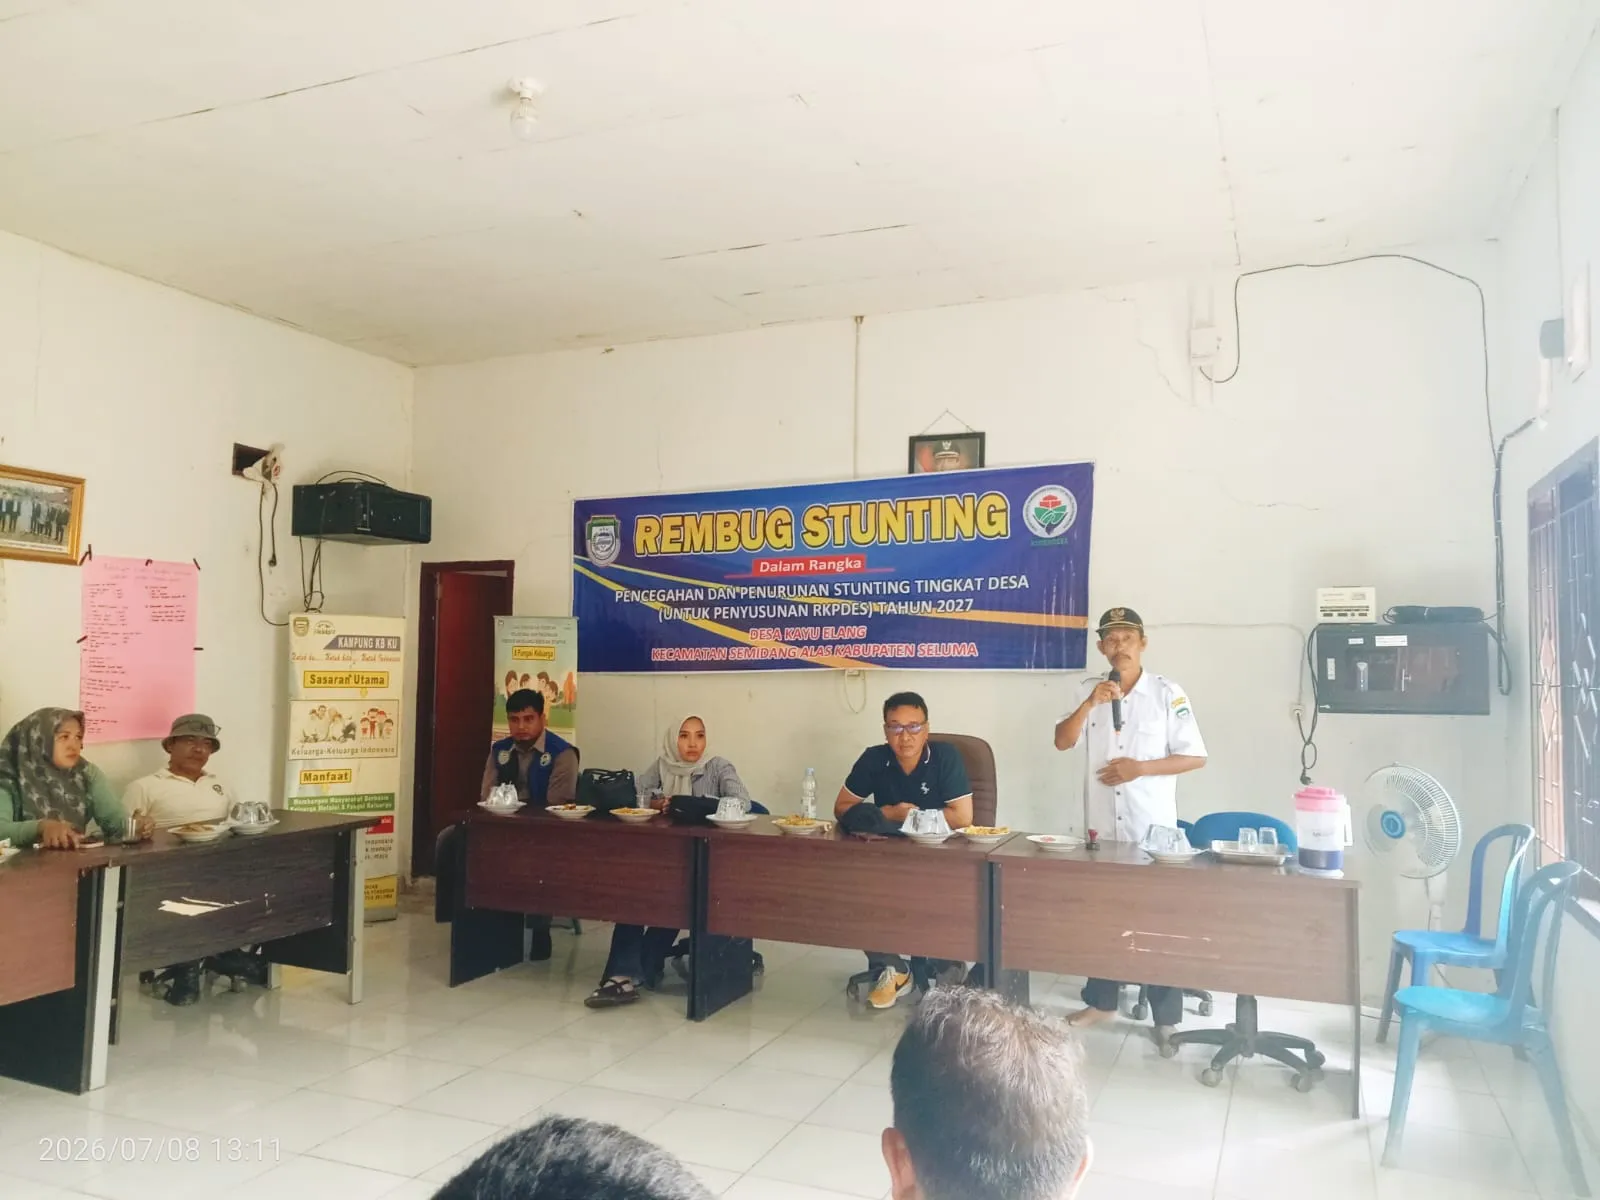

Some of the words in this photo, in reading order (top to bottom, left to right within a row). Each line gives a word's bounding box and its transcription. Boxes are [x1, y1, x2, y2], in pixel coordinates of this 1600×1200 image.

[634, 506, 794, 556] REMBUG
[801, 491, 1010, 549] STUNTING
[760, 560, 804, 573] Dalam
[809, 557, 862, 573] Rangka
[615, 587, 704, 603] PENCEGAHAN
[708, 587, 736, 601] DAN
[740, 584, 829, 599] PENURUNAN
[834, 580, 910, 596] STUNTING
[914, 577, 984, 593] TINGKAT
[988, 575, 1029, 590] DESA
[659, 607, 710, 623] (UNTUK
[714, 604, 809, 620] PENYUSUNAN
[813, 602, 873, 618] RKPDES)
[878, 600, 932, 615] TAHUN
[936, 598, 974, 613] 2027
[750, 628, 781, 641] DESA
[784, 627, 820, 640] KAYU
[822, 625, 867, 640] ELANG
[338, 636, 374, 648] KAMPUNG
[375, 637, 385, 649] KB
[651, 647, 728, 661] KECAMATAN
[729, 646, 797, 660] SEMIDANG
[799, 645, 832, 658] ALAS
[834, 643, 915, 658] KABUPATEN
[917, 642, 979, 657] SELUMA
[309, 674, 351, 685] Sasaran
[353, 674, 385, 685] Utama
[303, 771, 349, 782] Manfaat
